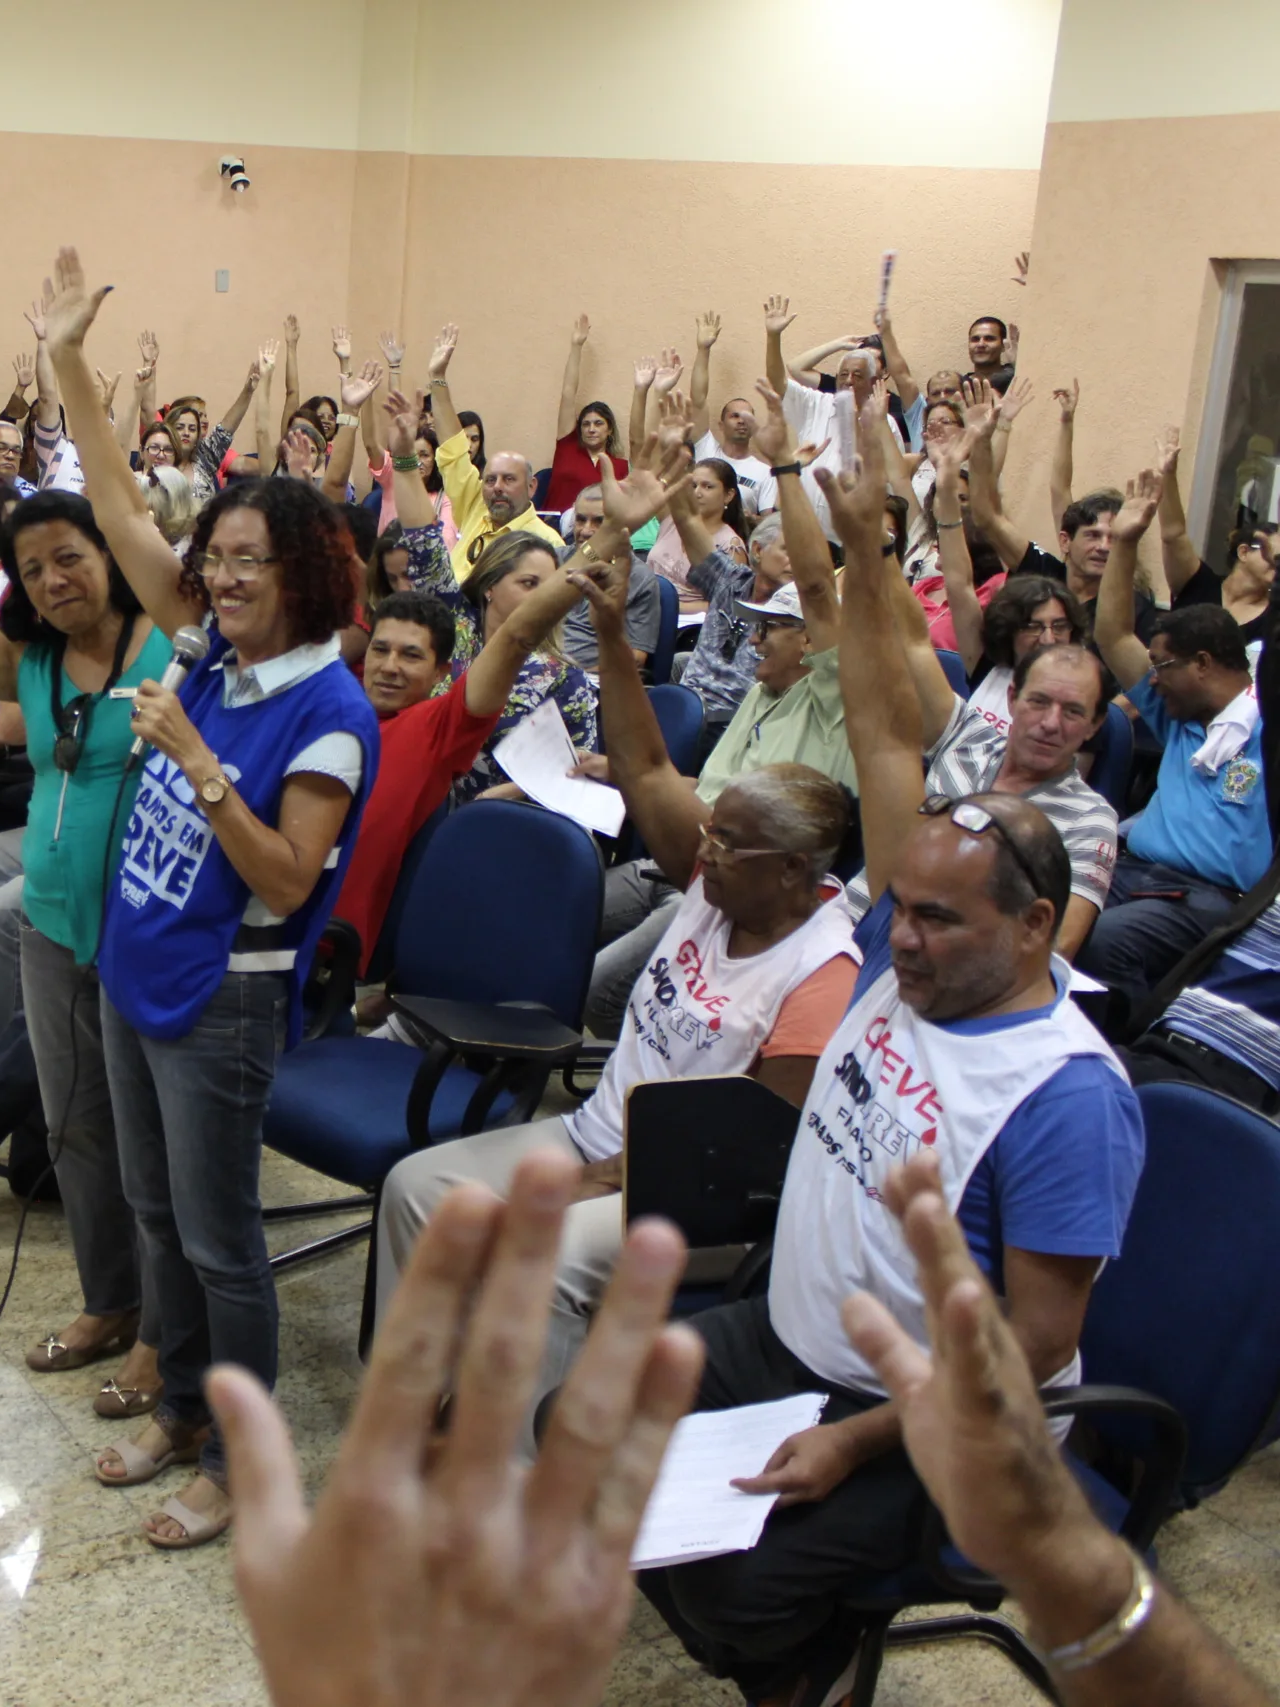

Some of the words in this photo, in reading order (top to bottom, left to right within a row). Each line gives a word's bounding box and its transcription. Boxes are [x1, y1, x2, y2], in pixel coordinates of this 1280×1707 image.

[137, 788, 177, 834] ANOS
[179, 822, 205, 854] EM
[865, 1017, 943, 1123] GEVE
